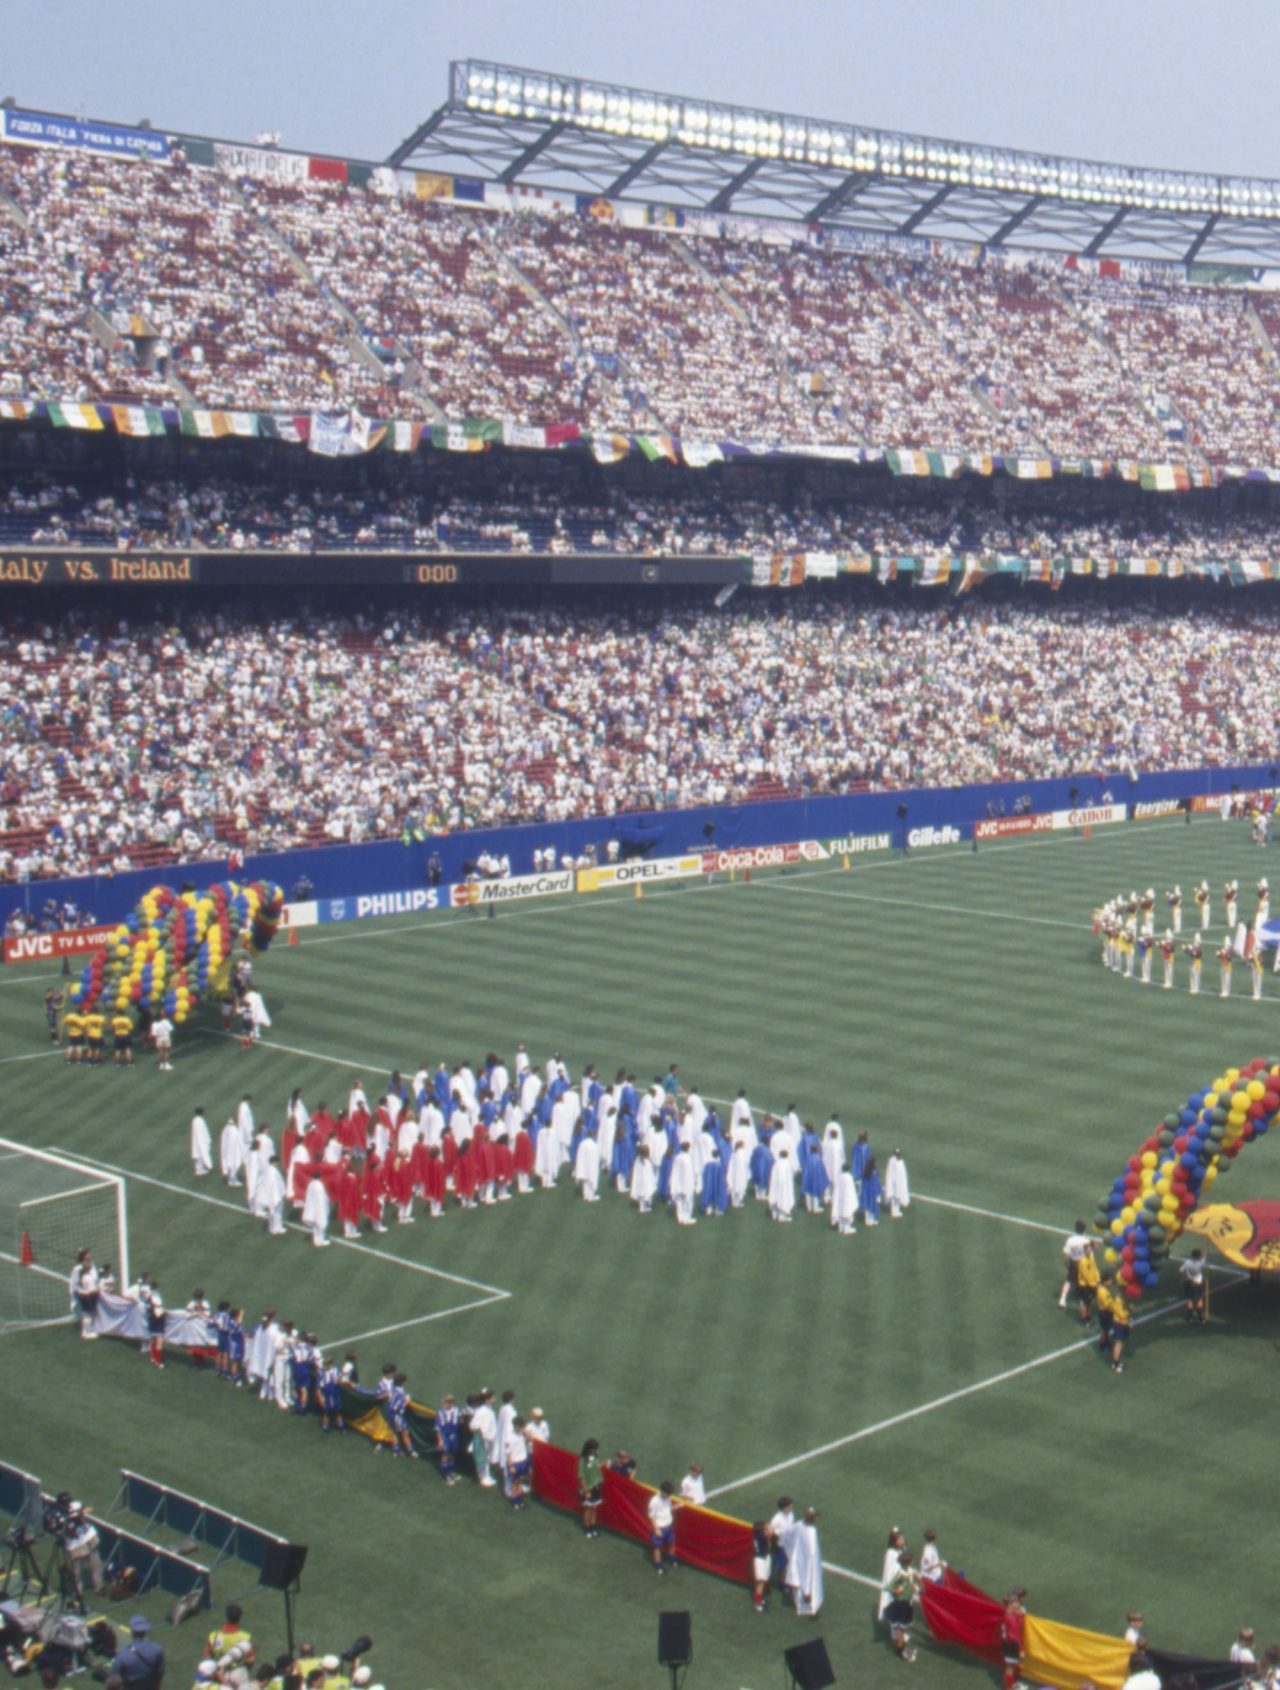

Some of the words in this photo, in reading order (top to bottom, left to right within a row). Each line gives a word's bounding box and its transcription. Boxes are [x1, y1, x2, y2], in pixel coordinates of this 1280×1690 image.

[64, 560, 99, 580] vs.
[111, 557, 191, 580] Ireland
[1068, 809, 1112, 825] Canon
[1136, 800, 1180, 817] Energizer
[976, 820, 998, 837] JVC
[1032, 814, 1052, 830] JVC
[830, 834, 889, 855] FUJIFILM
[908, 826, 960, 847] Gillette
[718, 846, 784, 870] Coca-Cola
[616, 865, 662, 881] OPEL
[482, 874, 570, 901] MasterCard
[357, 888, 438, 918] PHILIPS
[9, 933, 53, 957] JVC
[58, 936, 74, 948] TV
[76, 934, 85, 947] &
